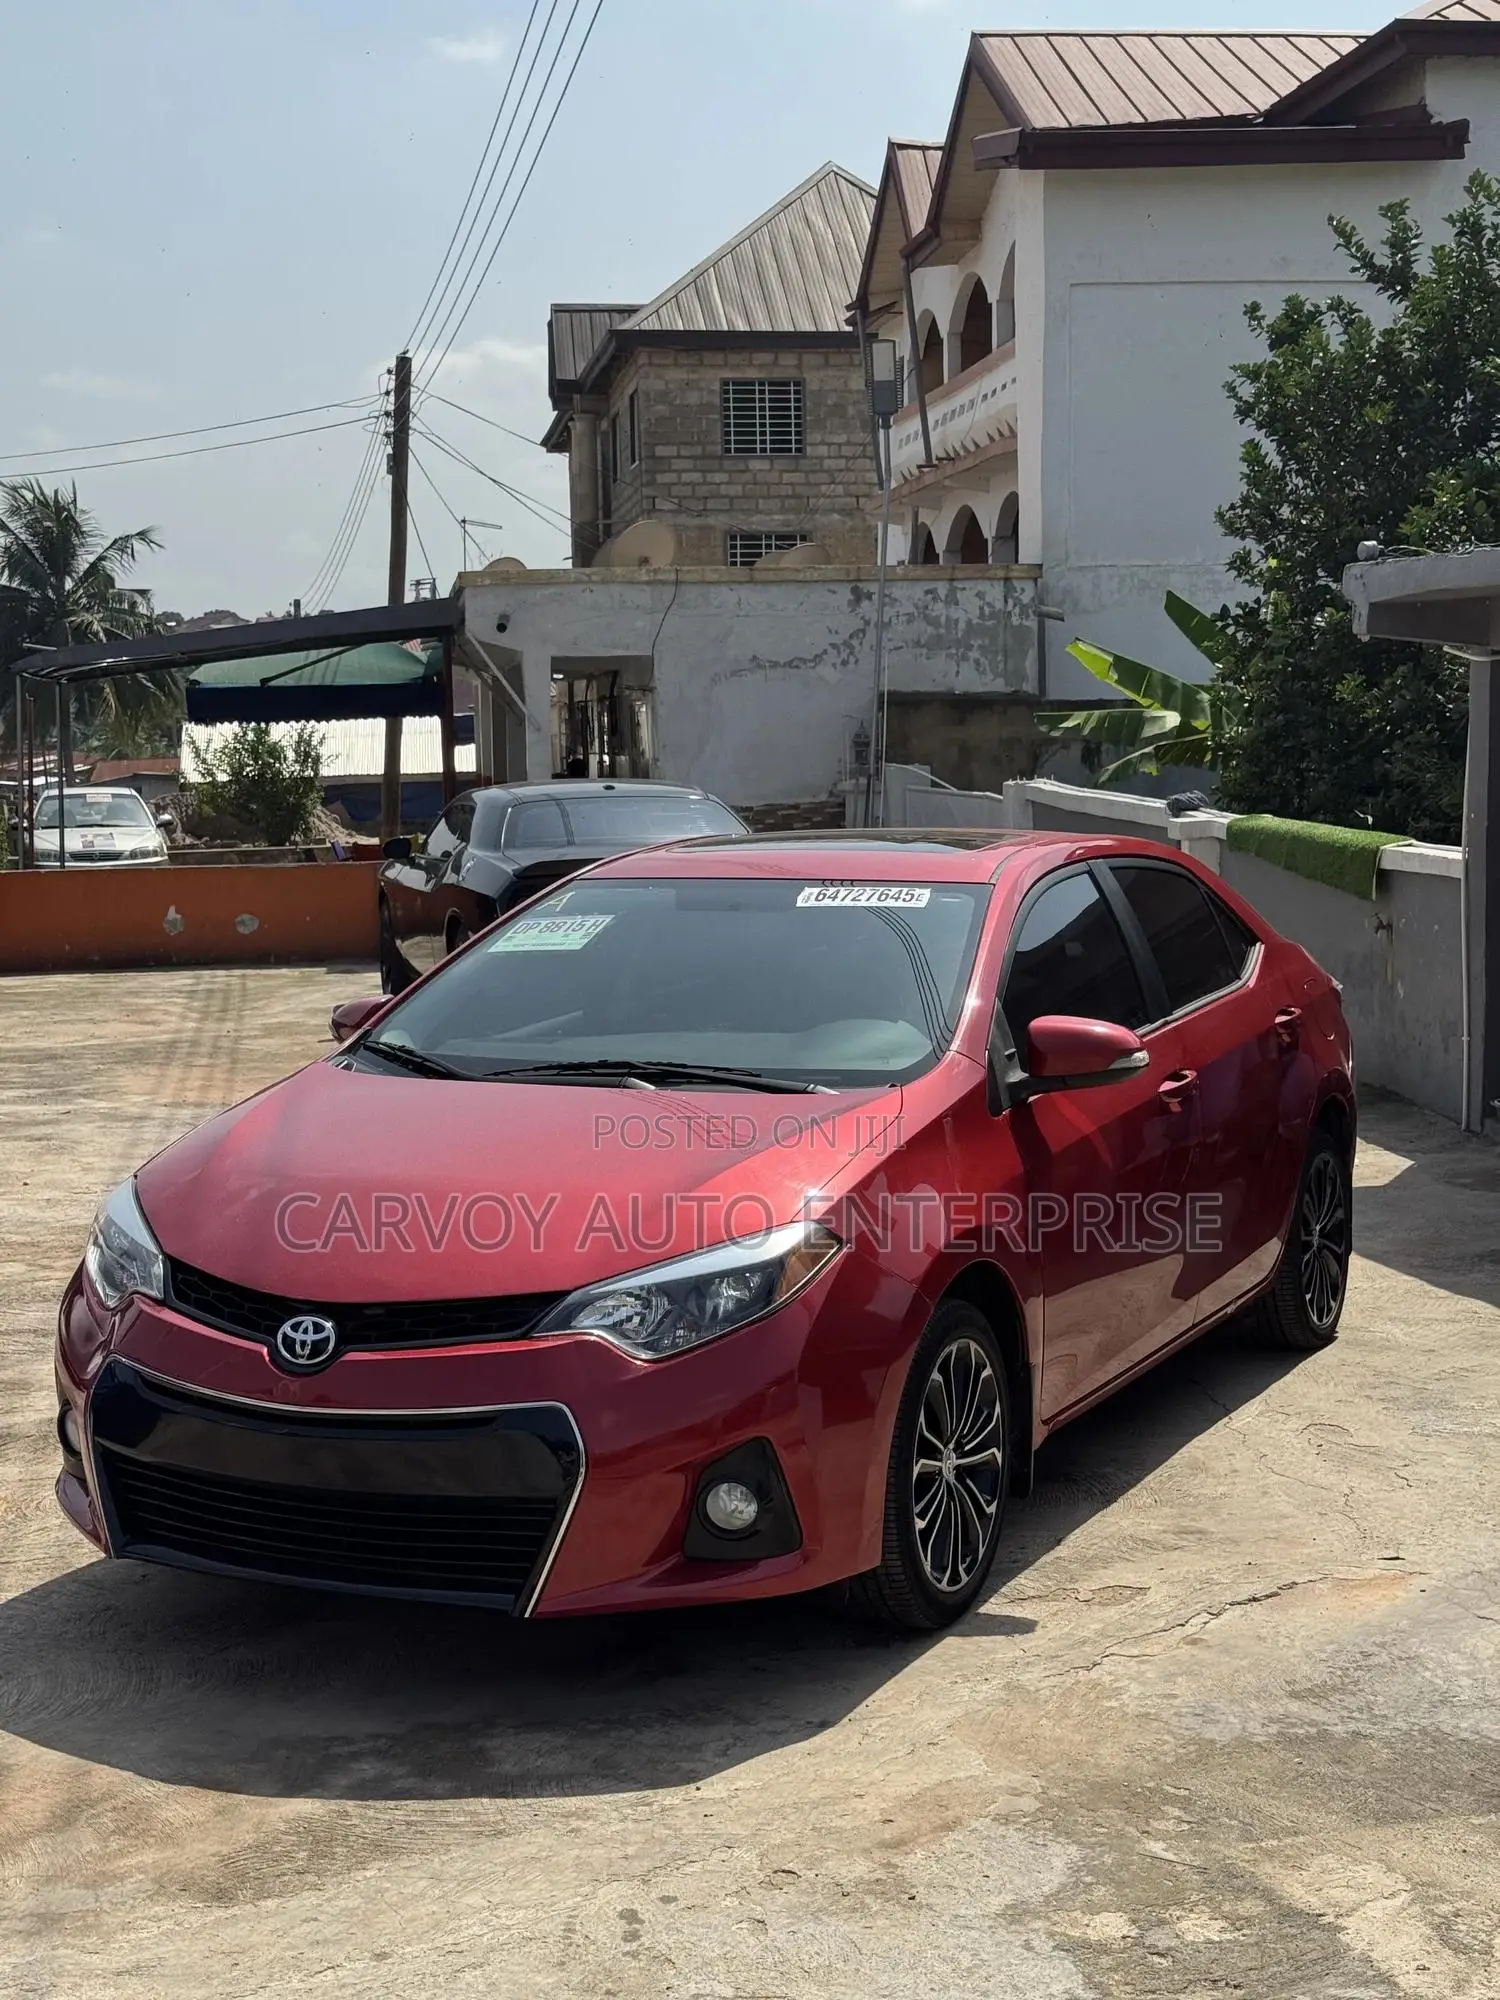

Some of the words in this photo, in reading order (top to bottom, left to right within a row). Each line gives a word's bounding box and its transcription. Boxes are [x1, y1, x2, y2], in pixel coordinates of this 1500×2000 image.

[814, 888, 916, 902] 64727645
[513, 921, 540, 934] DP
[586, 919, 606, 932] H
